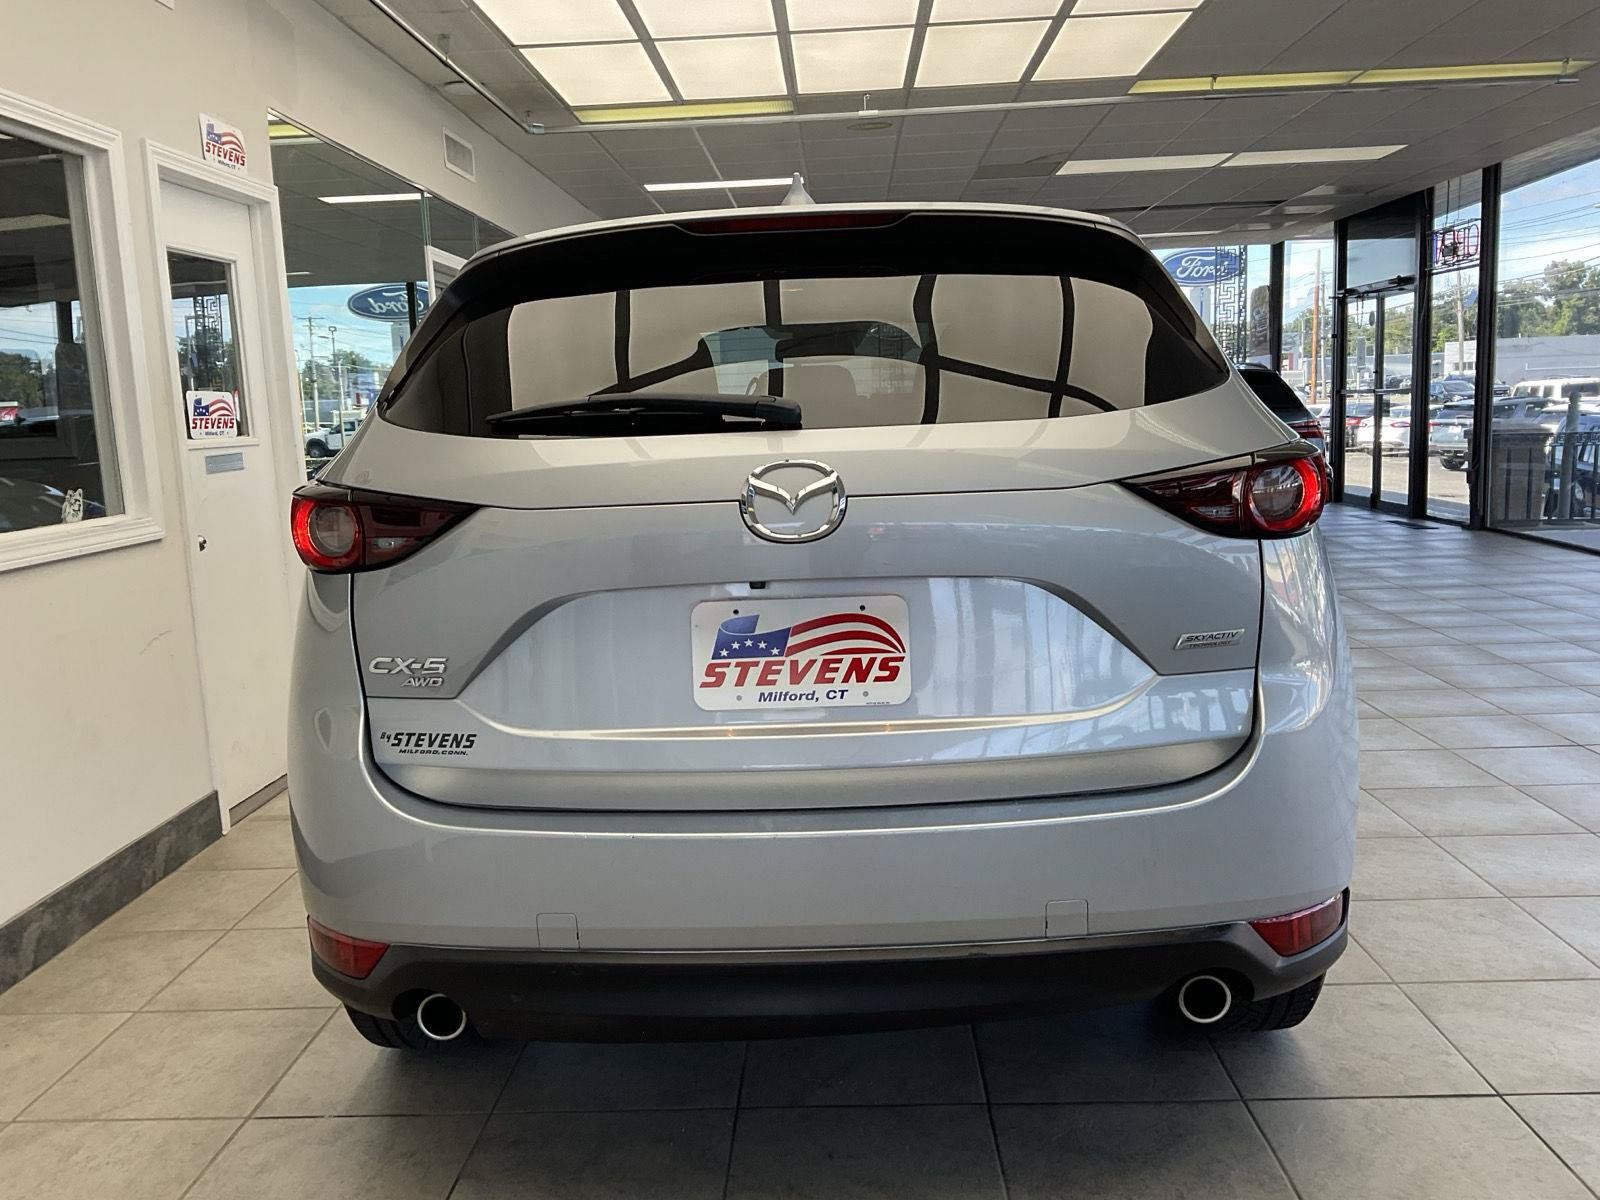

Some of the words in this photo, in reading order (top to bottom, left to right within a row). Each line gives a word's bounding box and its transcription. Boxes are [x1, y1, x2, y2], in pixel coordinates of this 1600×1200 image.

[205, 141, 246, 167] STEVENS
[1176, 256, 1229, 278] Ford
[191, 417, 235, 430] STEVENS
[1186, 631, 1239, 643] SKYACTIV
[368, 657, 447, 675] CX-5
[699, 656, 905, 689] STEVENS
[401, 677, 443, 688] AWD
[758, 690, 819, 703] Milford,
[826, 689, 849, 700] CT
[391, 732, 478, 749] STEVENS
